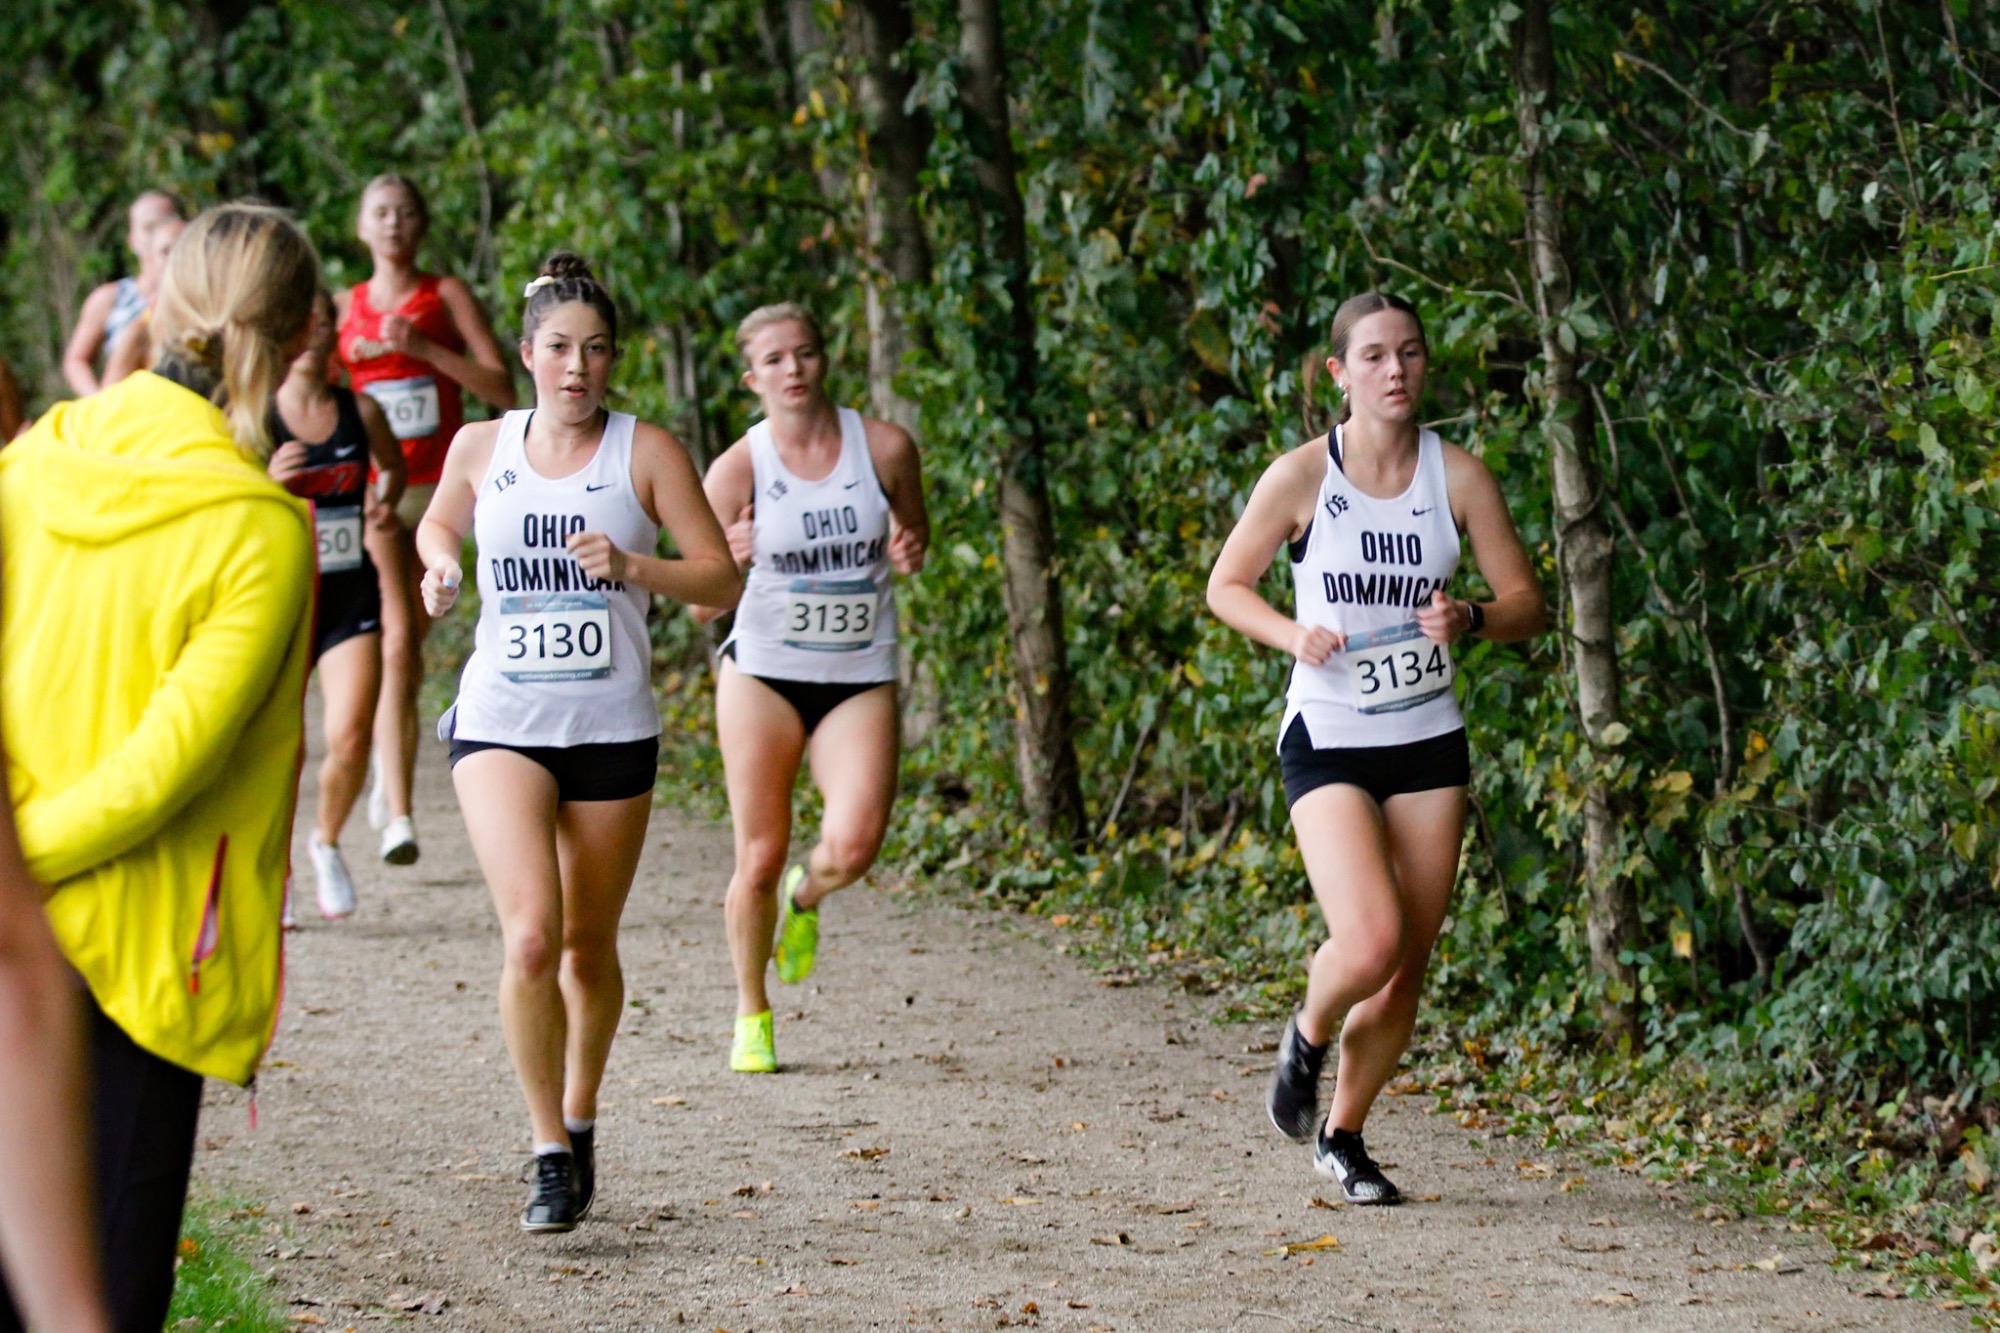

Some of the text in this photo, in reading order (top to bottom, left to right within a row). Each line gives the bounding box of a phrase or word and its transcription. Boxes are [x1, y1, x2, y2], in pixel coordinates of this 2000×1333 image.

[802, 505, 858, 540] OHIO
[1360, 530, 1422, 566] OHIO
[792, 602, 870, 633] 3133
[507, 621, 603, 660] 3130
[1356, 644, 1447, 695] 3134
